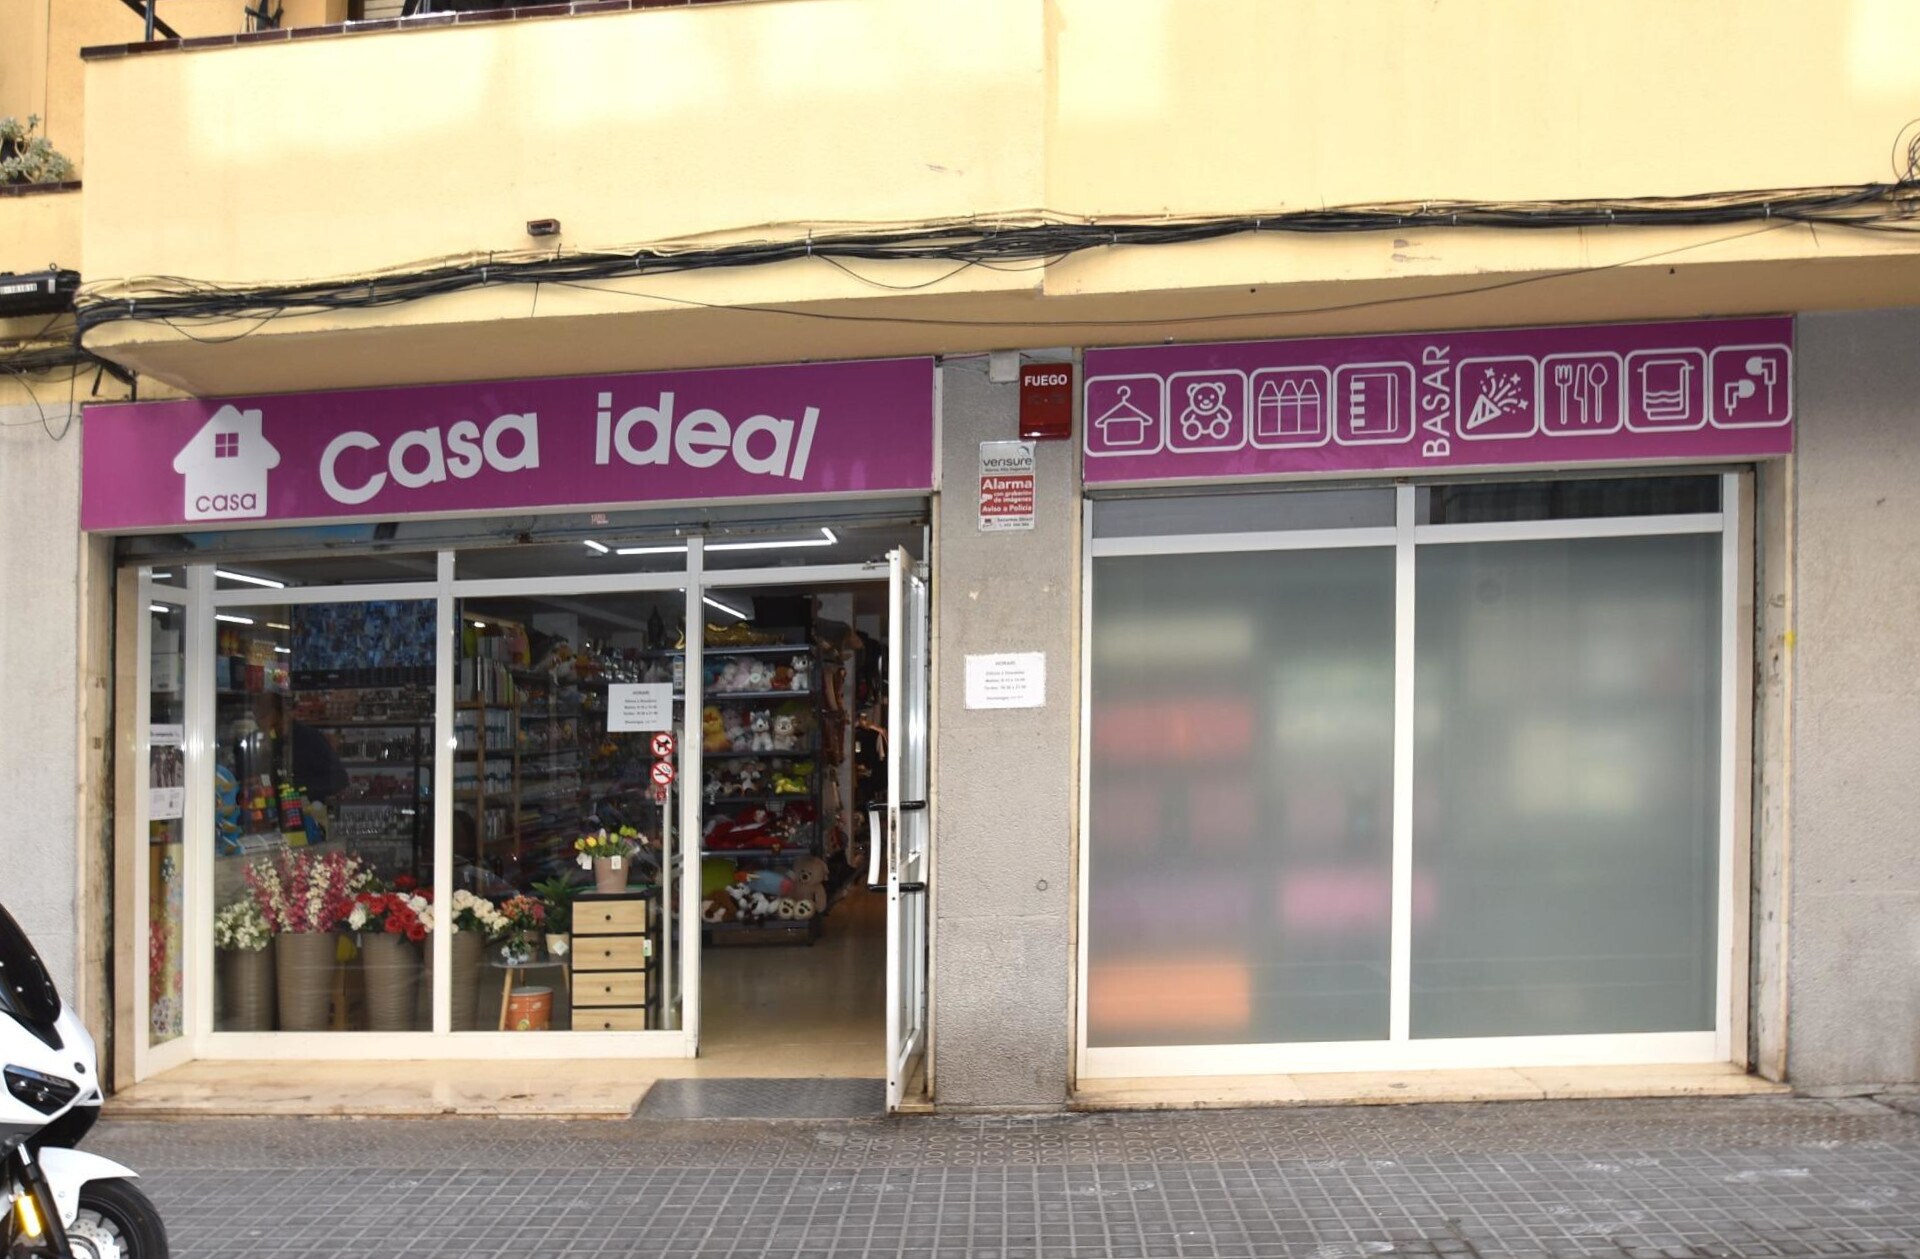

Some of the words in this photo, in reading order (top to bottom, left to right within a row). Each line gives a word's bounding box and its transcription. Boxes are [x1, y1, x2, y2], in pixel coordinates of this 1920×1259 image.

[1024, 374, 1068, 387] FUEGO
[1422, 346, 1450, 457] BASAR
[595, 392, 820, 481] ideal
[983, 457, 1032, 467] verisure
[982, 478, 1033, 490] Alarma
[195, 493, 257, 512] casa
